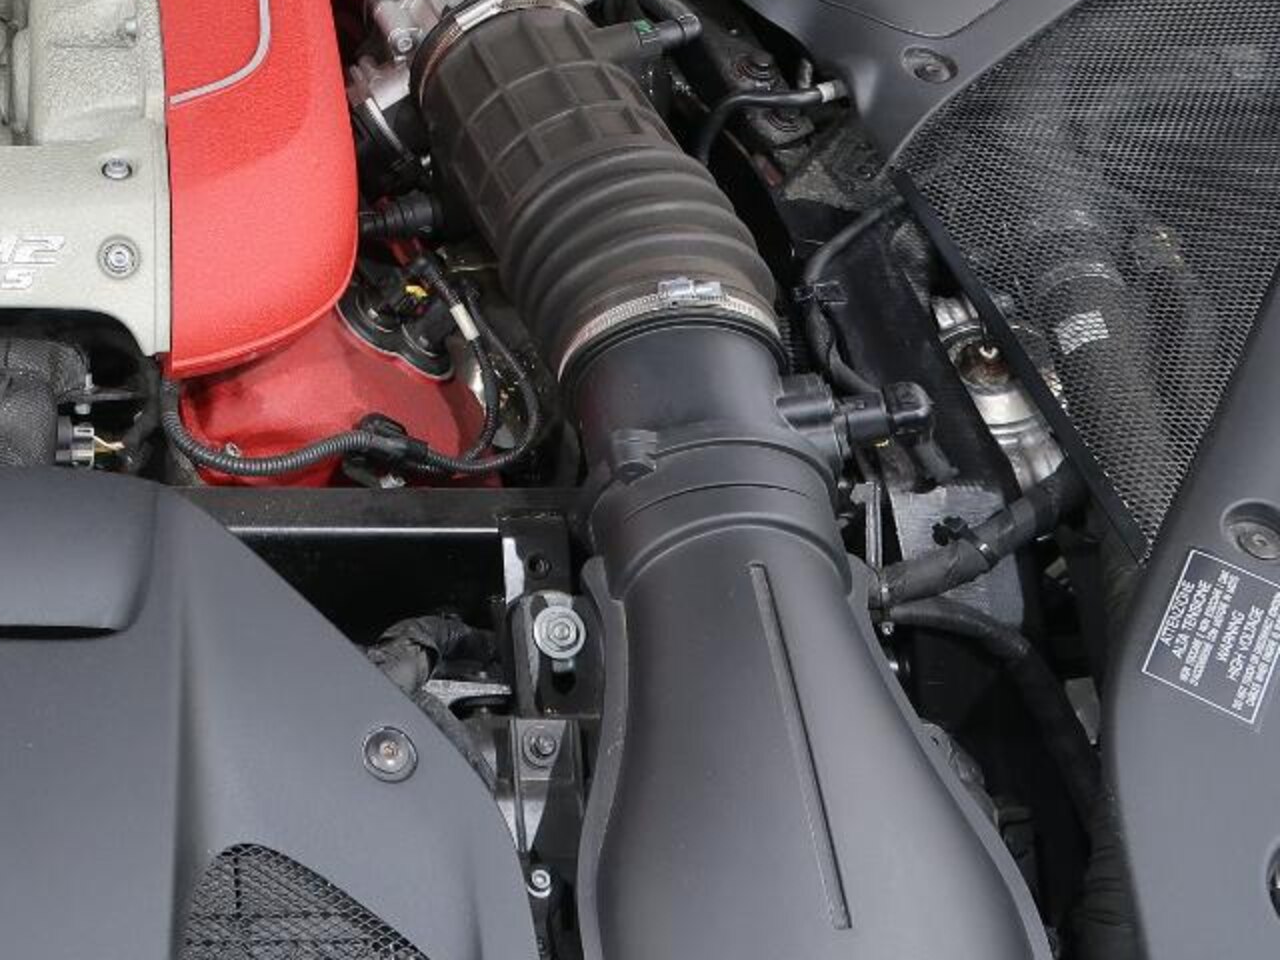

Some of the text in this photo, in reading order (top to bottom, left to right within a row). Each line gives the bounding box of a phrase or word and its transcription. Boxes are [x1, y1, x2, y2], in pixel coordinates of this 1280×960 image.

[1160, 580, 1195, 647] ATTENZIONE
[1172, 633, 1190, 659] ALTA
[1182, 580, 1212, 630] TENSIONE
[1216, 609, 1246, 663] WARNING
[1226, 651, 1247, 682] HIGH
[1238, 605, 1265, 652] VOLTAGE
